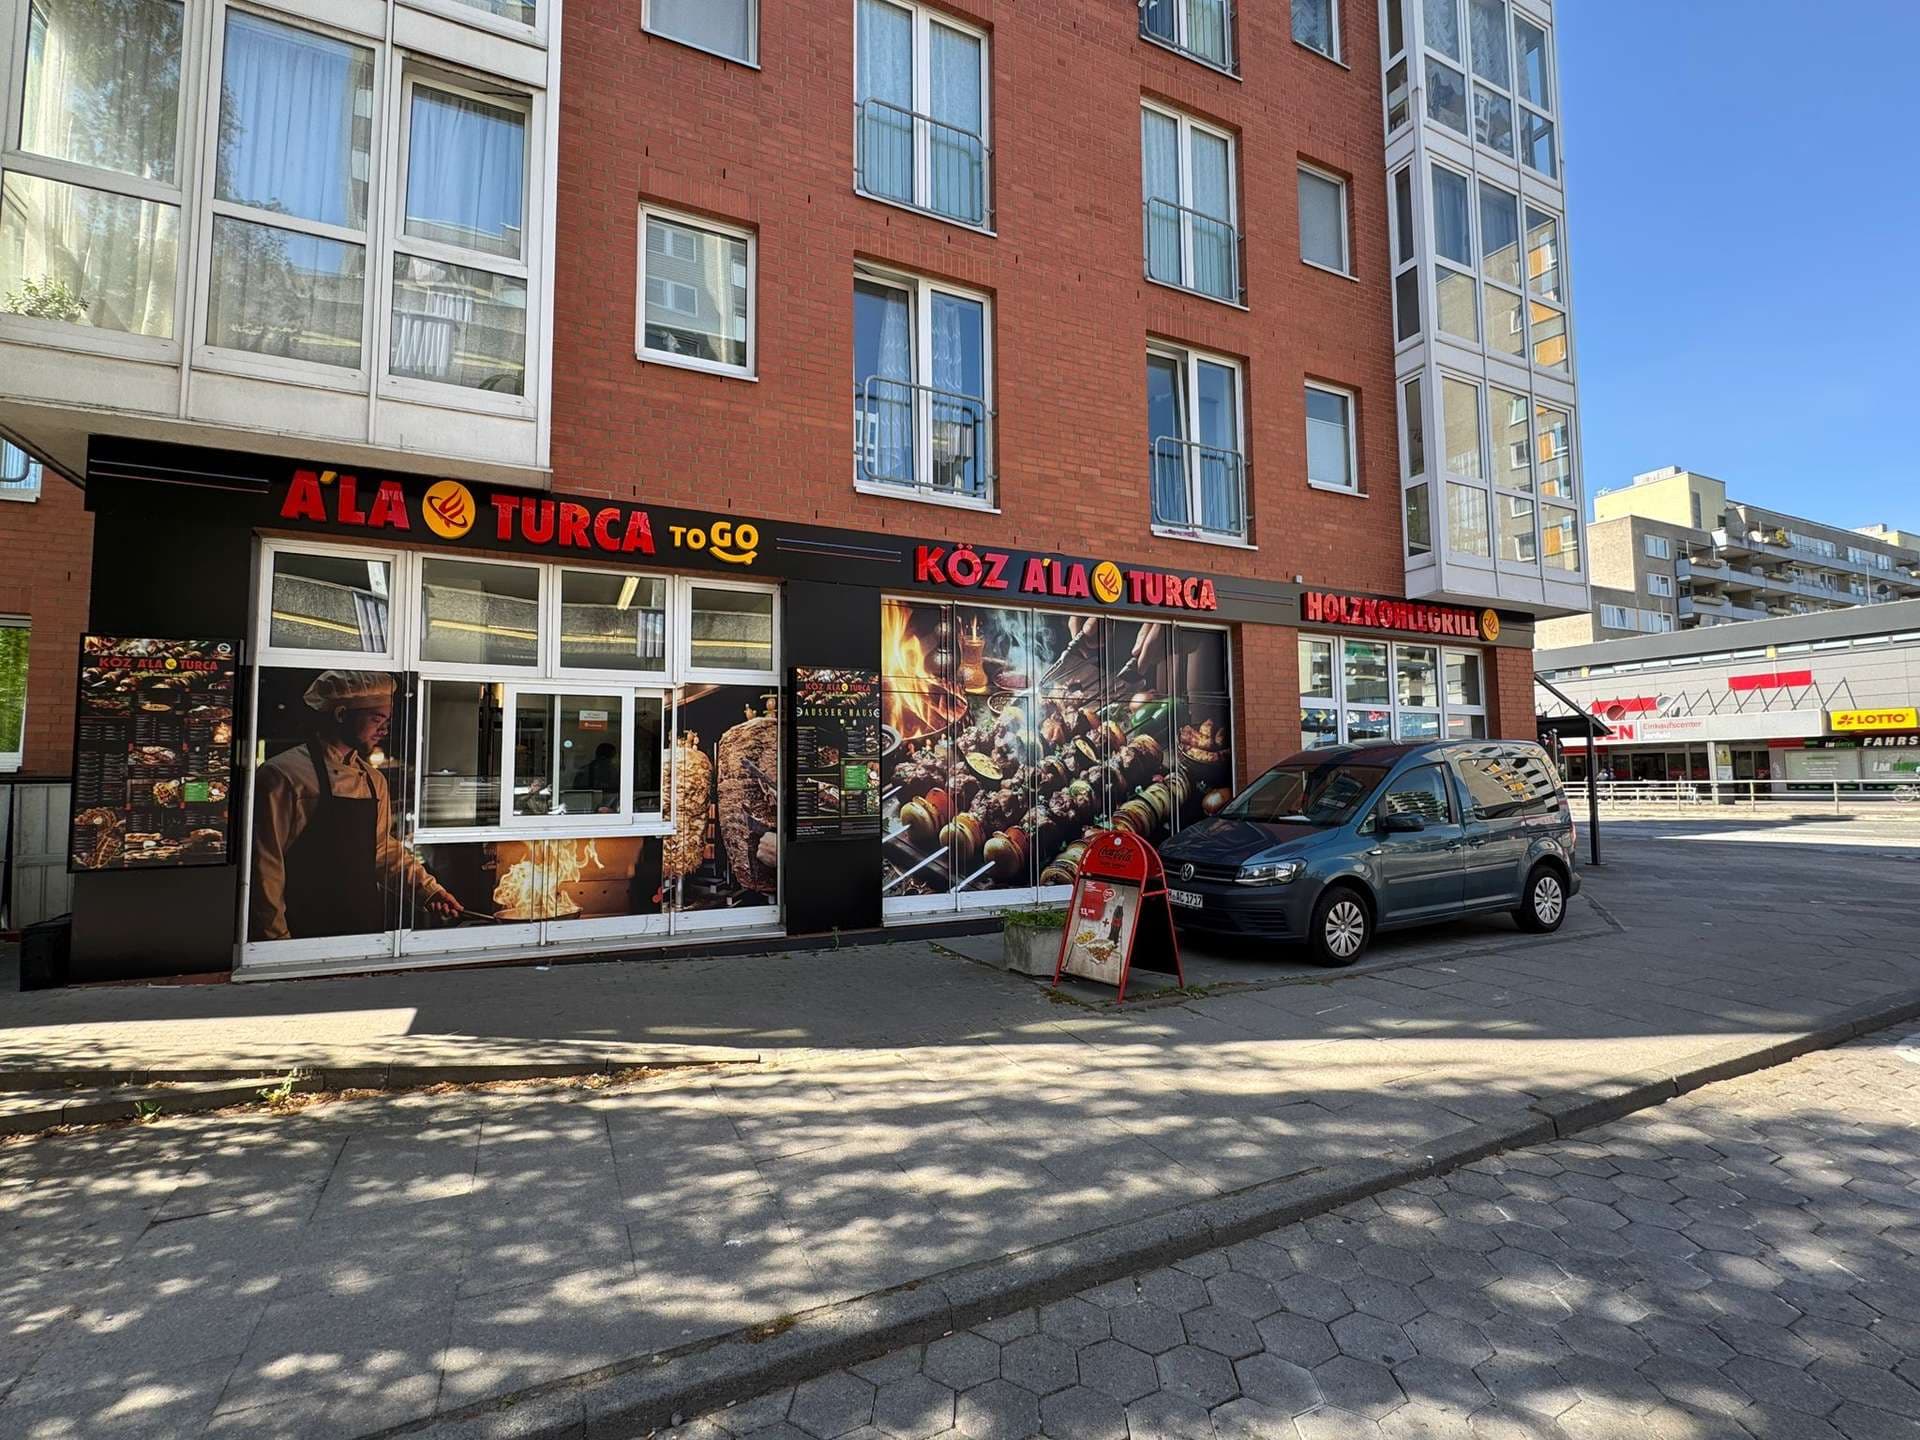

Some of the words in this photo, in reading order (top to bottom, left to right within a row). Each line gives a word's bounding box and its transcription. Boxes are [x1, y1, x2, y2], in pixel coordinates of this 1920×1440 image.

[491, 494, 656, 555] TURCA
[669, 525, 706, 550] TO
[710, 521, 759, 550] GO
[915, 543, 1009, 590] KÖZ
[1127, 570, 1217, 611] TURCA
[1303, 591, 1480, 638] HOLZKOHLEGRILL
[180, 658, 218, 671] TURCA
[1857, 713, 1906, 725] LOTTO
